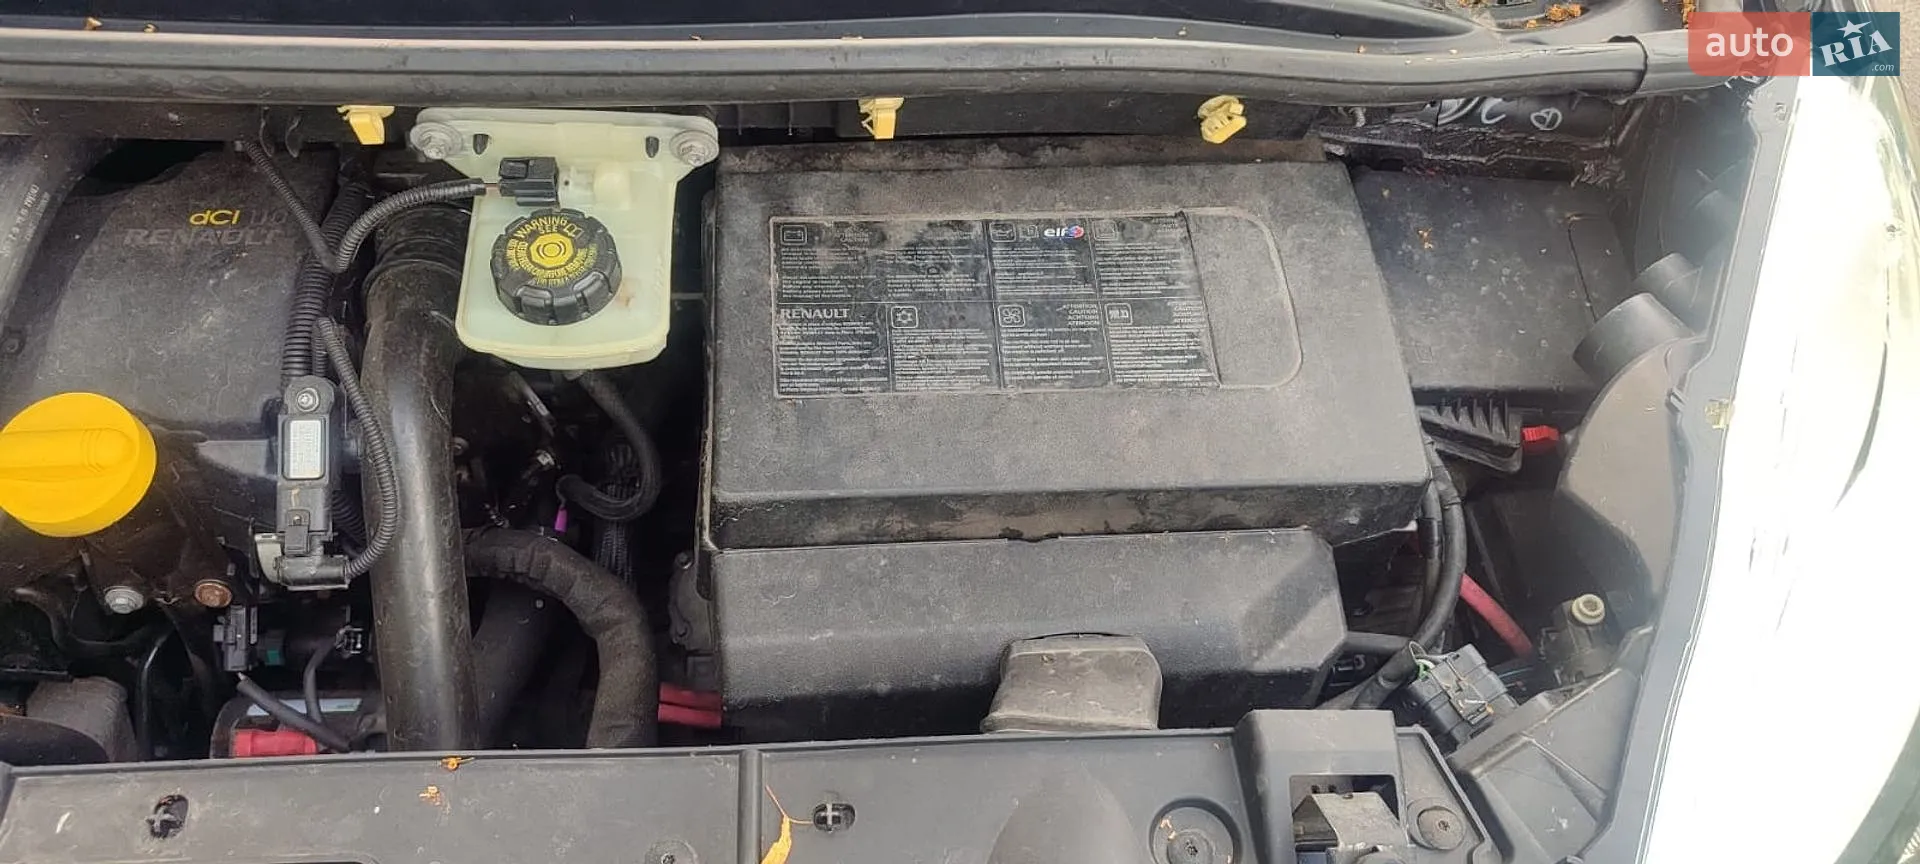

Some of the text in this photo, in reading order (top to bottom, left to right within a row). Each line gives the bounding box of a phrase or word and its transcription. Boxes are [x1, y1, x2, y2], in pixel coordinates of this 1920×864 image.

[513, 216, 568, 239] WARNING
[538, 225, 558, 234] SEE
[123, 228, 285, 247] RENAULT
[780, 308, 850, 319] RENAULT
